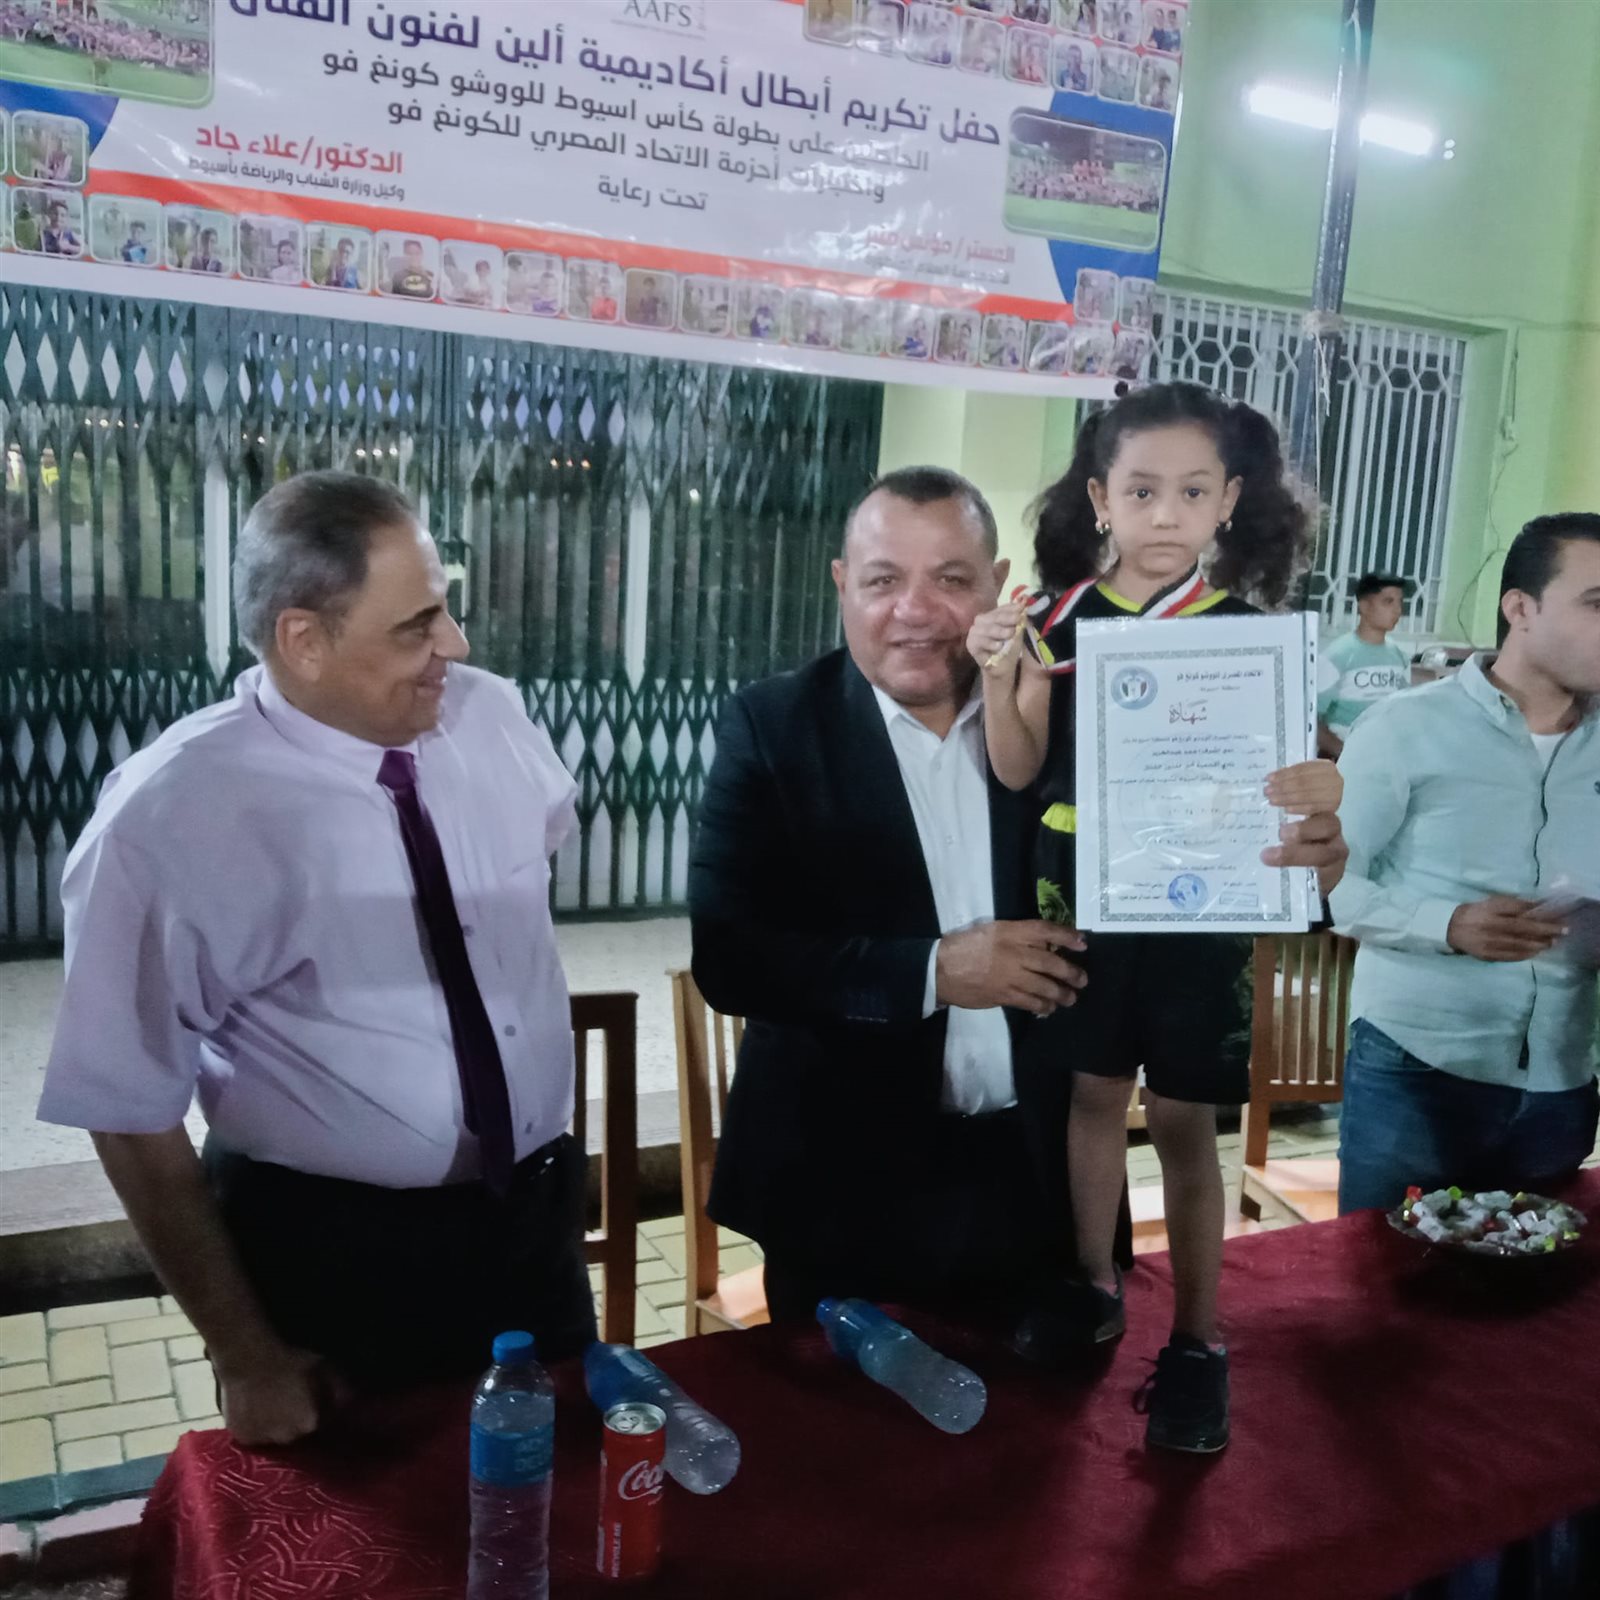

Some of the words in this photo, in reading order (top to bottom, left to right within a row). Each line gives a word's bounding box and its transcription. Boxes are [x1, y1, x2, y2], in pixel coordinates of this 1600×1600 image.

[367, 3, 480, 48] لفنون
[624, 0, 692, 27] AAFS
[496, 23, 564, 69] ألين
[323, 50, 358, 75] فو
[370, 54, 440, 88] كونغ
[579, 37, 728, 95] أكاديمية
[451, 69, 544, 107] للووشو
[554, 86, 636, 121] اسيوط
[741, 70, 831, 120] أبطال
[388, 98, 422, 125] فو
[433, 103, 521, 138] للكونغ
[646, 102, 703, 132] كأس
[844, 97, 931, 132] تكريم
[940, 108, 1000, 145] حفل
[196, 124, 241, 155] جاد
[531, 131, 626, 155] المصري
[713, 115, 780, 149] بطولة
[789, 131, 836, 154] على
[188, 156, 239, 176] بأسيوط
[635, 138, 708, 168] الاتحاد
[718, 149, 780, 183] أحزمة
[241, 161, 294, 186] والرياضة
[296, 172, 340, 189] الشباب
[341, 175, 371, 196] وزارة
[373, 183, 405, 201] وكيل
[598, 174, 650, 208] رعاية
[660, 188, 709, 211] تحت
